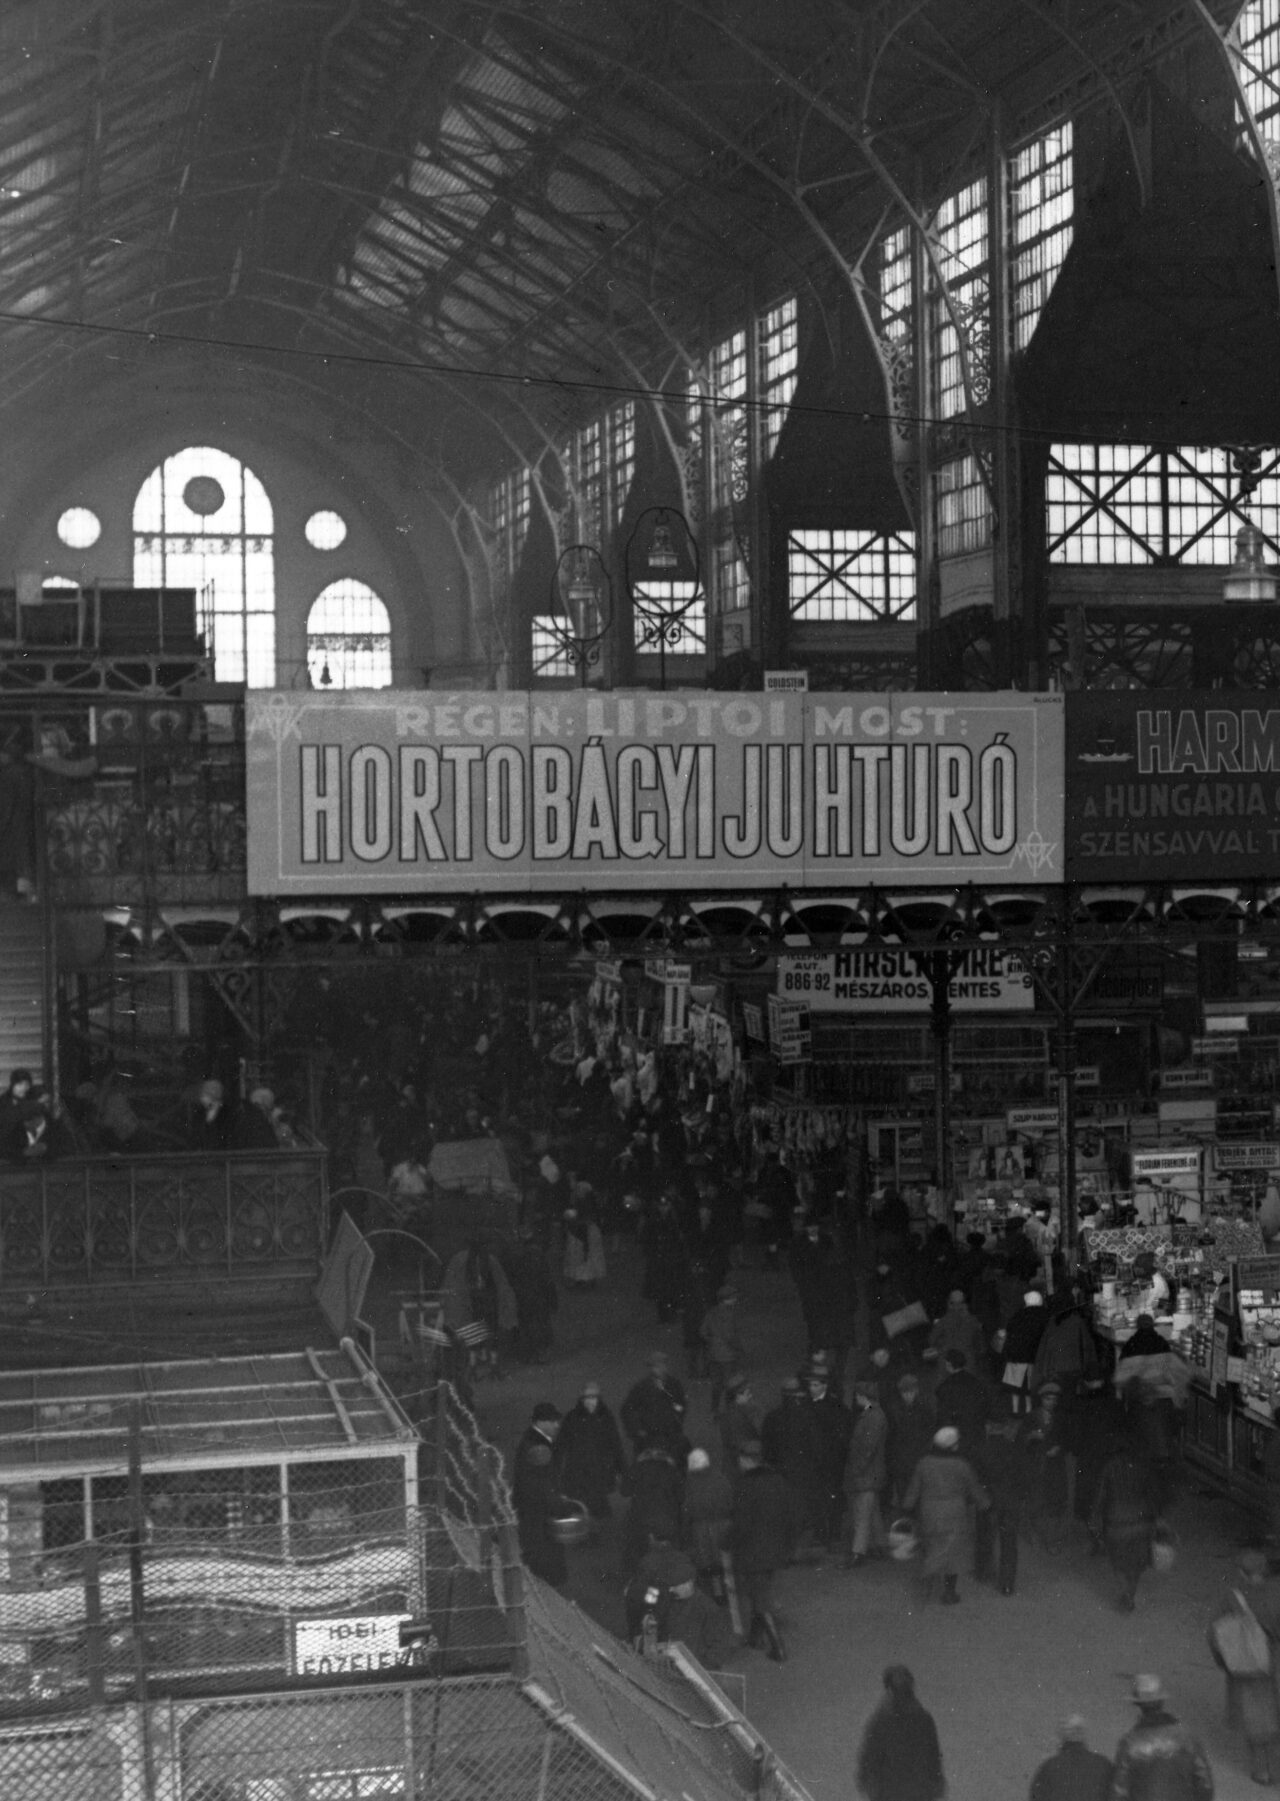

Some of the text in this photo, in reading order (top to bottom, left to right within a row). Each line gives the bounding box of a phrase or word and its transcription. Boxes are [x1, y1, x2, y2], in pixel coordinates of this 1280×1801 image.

[396, 697, 575, 737] RÉGEN:
[815, 705, 968, 738] MOST:
[299, 733, 1018, 863] HORTOBÁGYI JUHTURÓ
[834, 950, 933, 978] HIRSC
[948, 981, 1001, 999] ENTES
